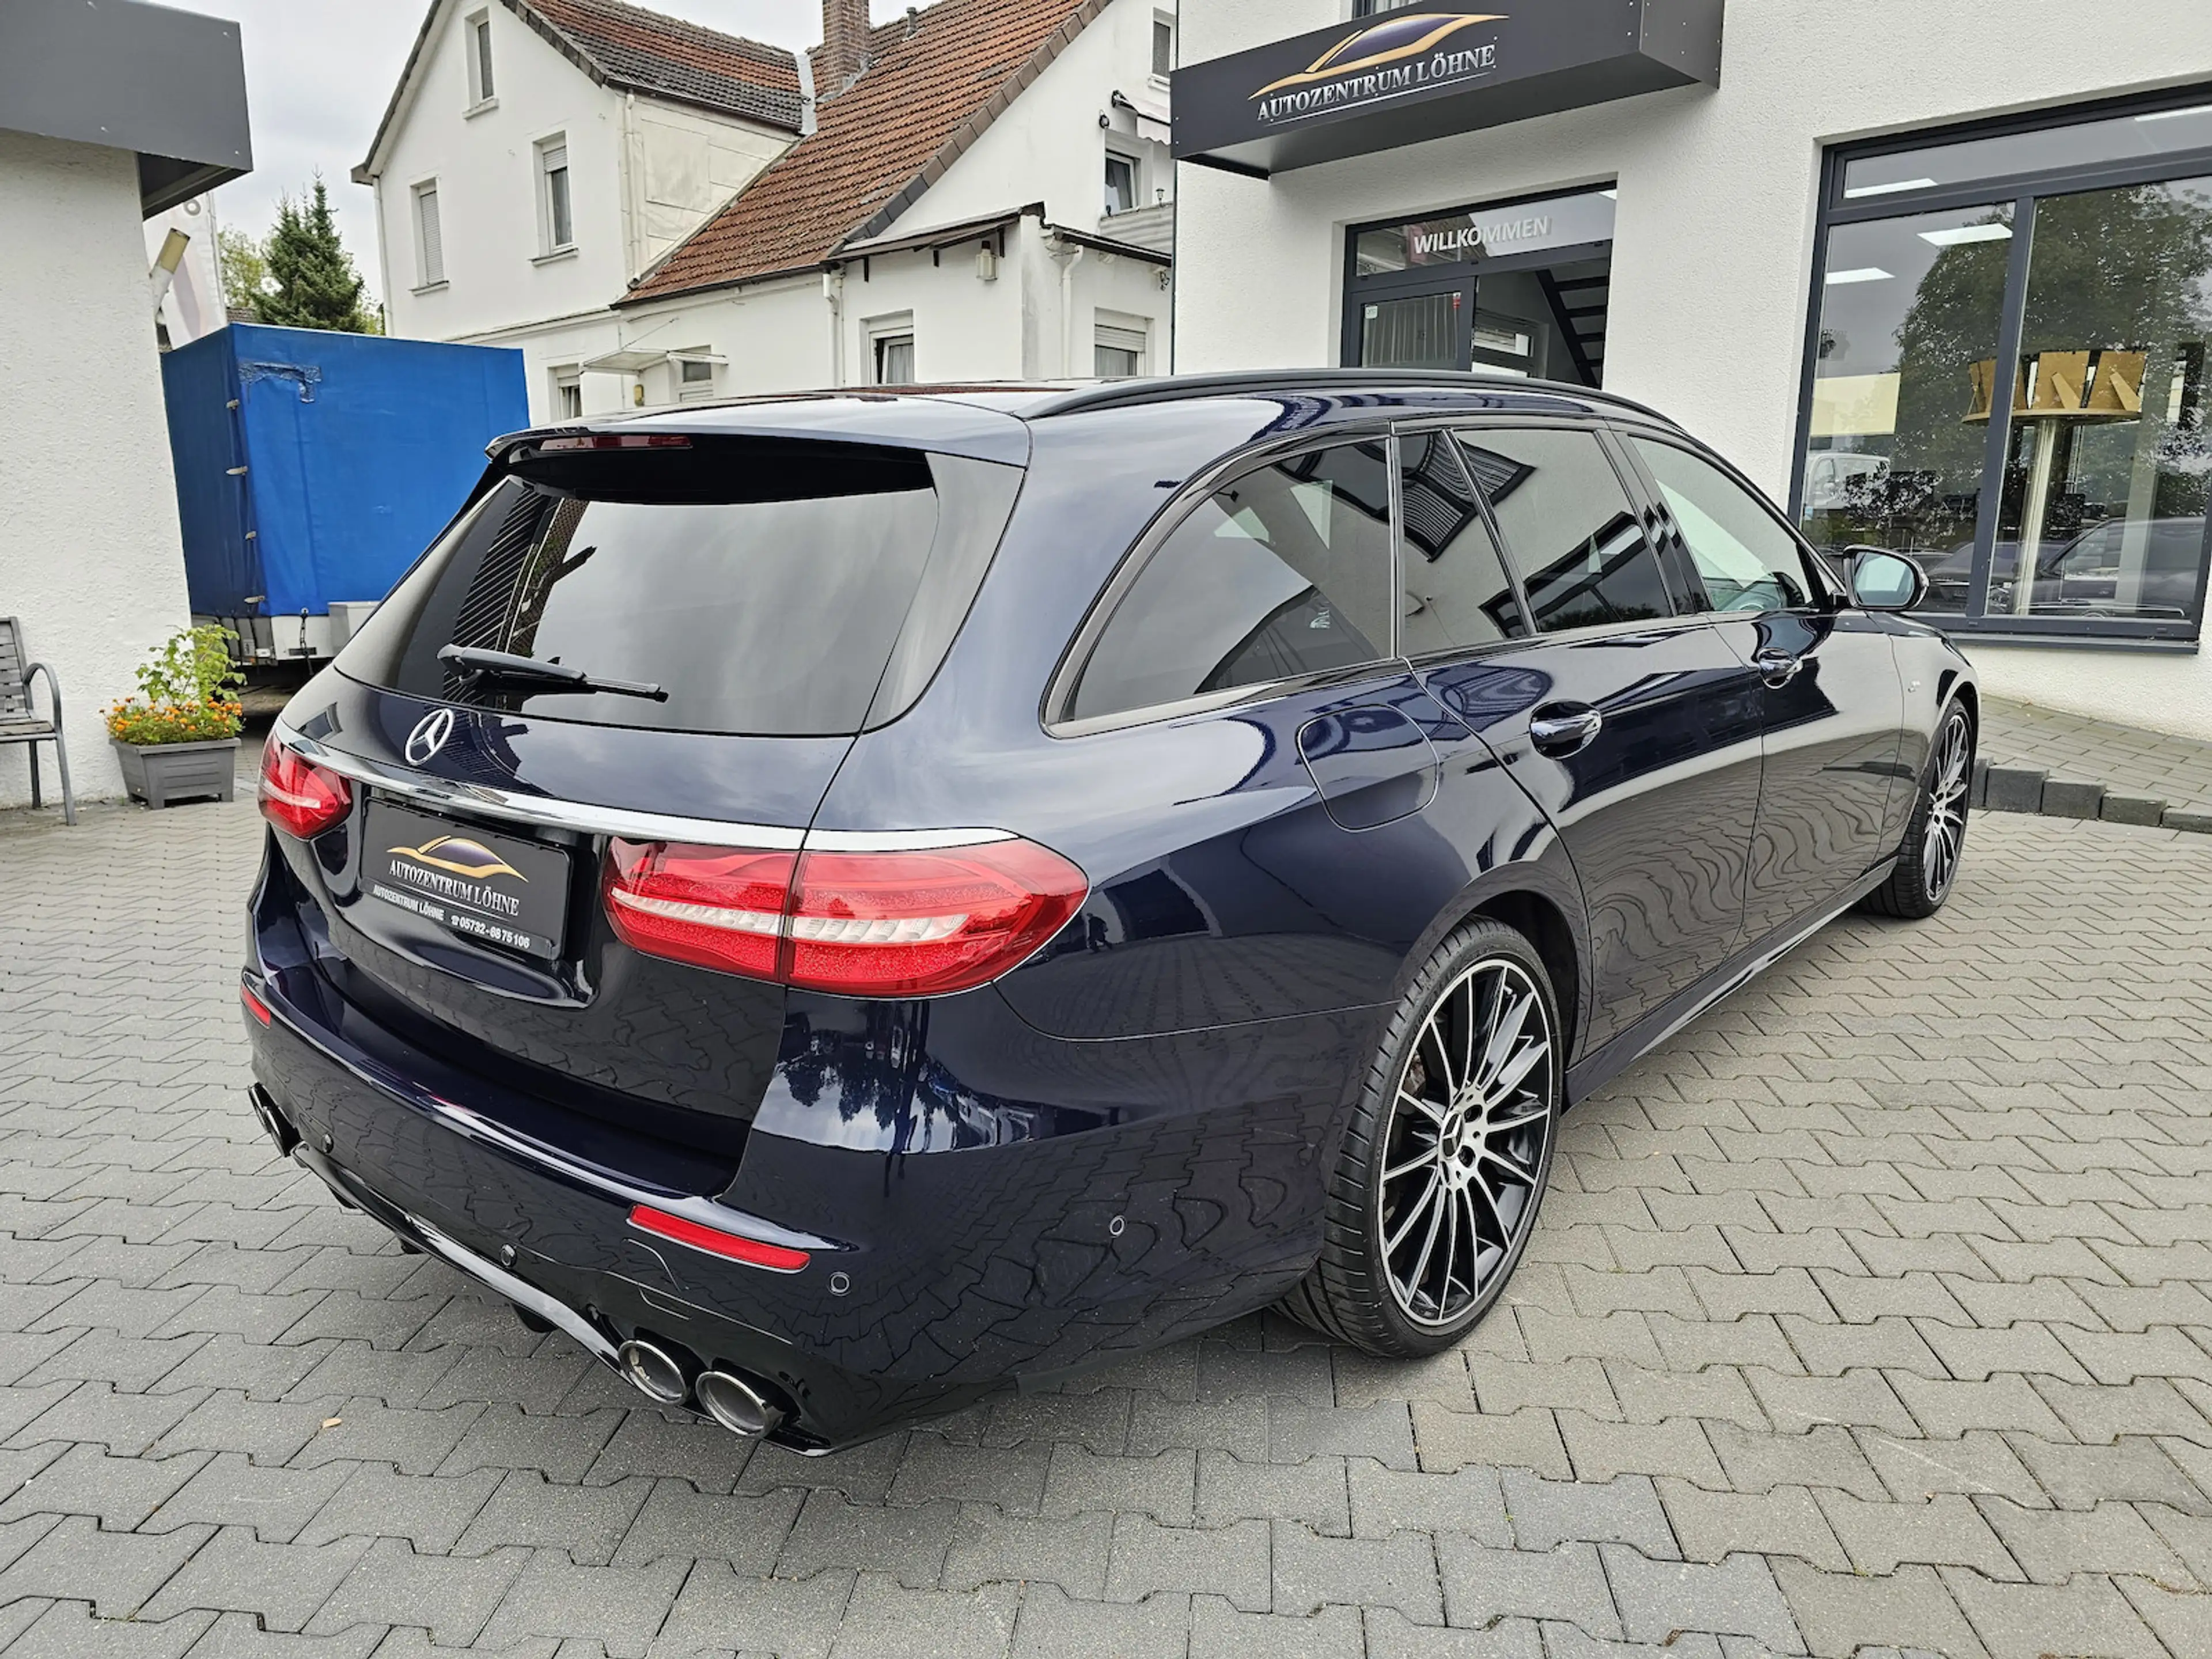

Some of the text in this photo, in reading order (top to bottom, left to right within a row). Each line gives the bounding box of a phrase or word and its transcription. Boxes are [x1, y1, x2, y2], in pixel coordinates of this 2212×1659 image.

[1257, 44, 1496, 122] AUTOZENTRUM LÖHNE
[1414, 215, 1549, 254] WILLKOMMEN
[389, 859, 520, 916] AUTOZENTRUM LÖHNE
